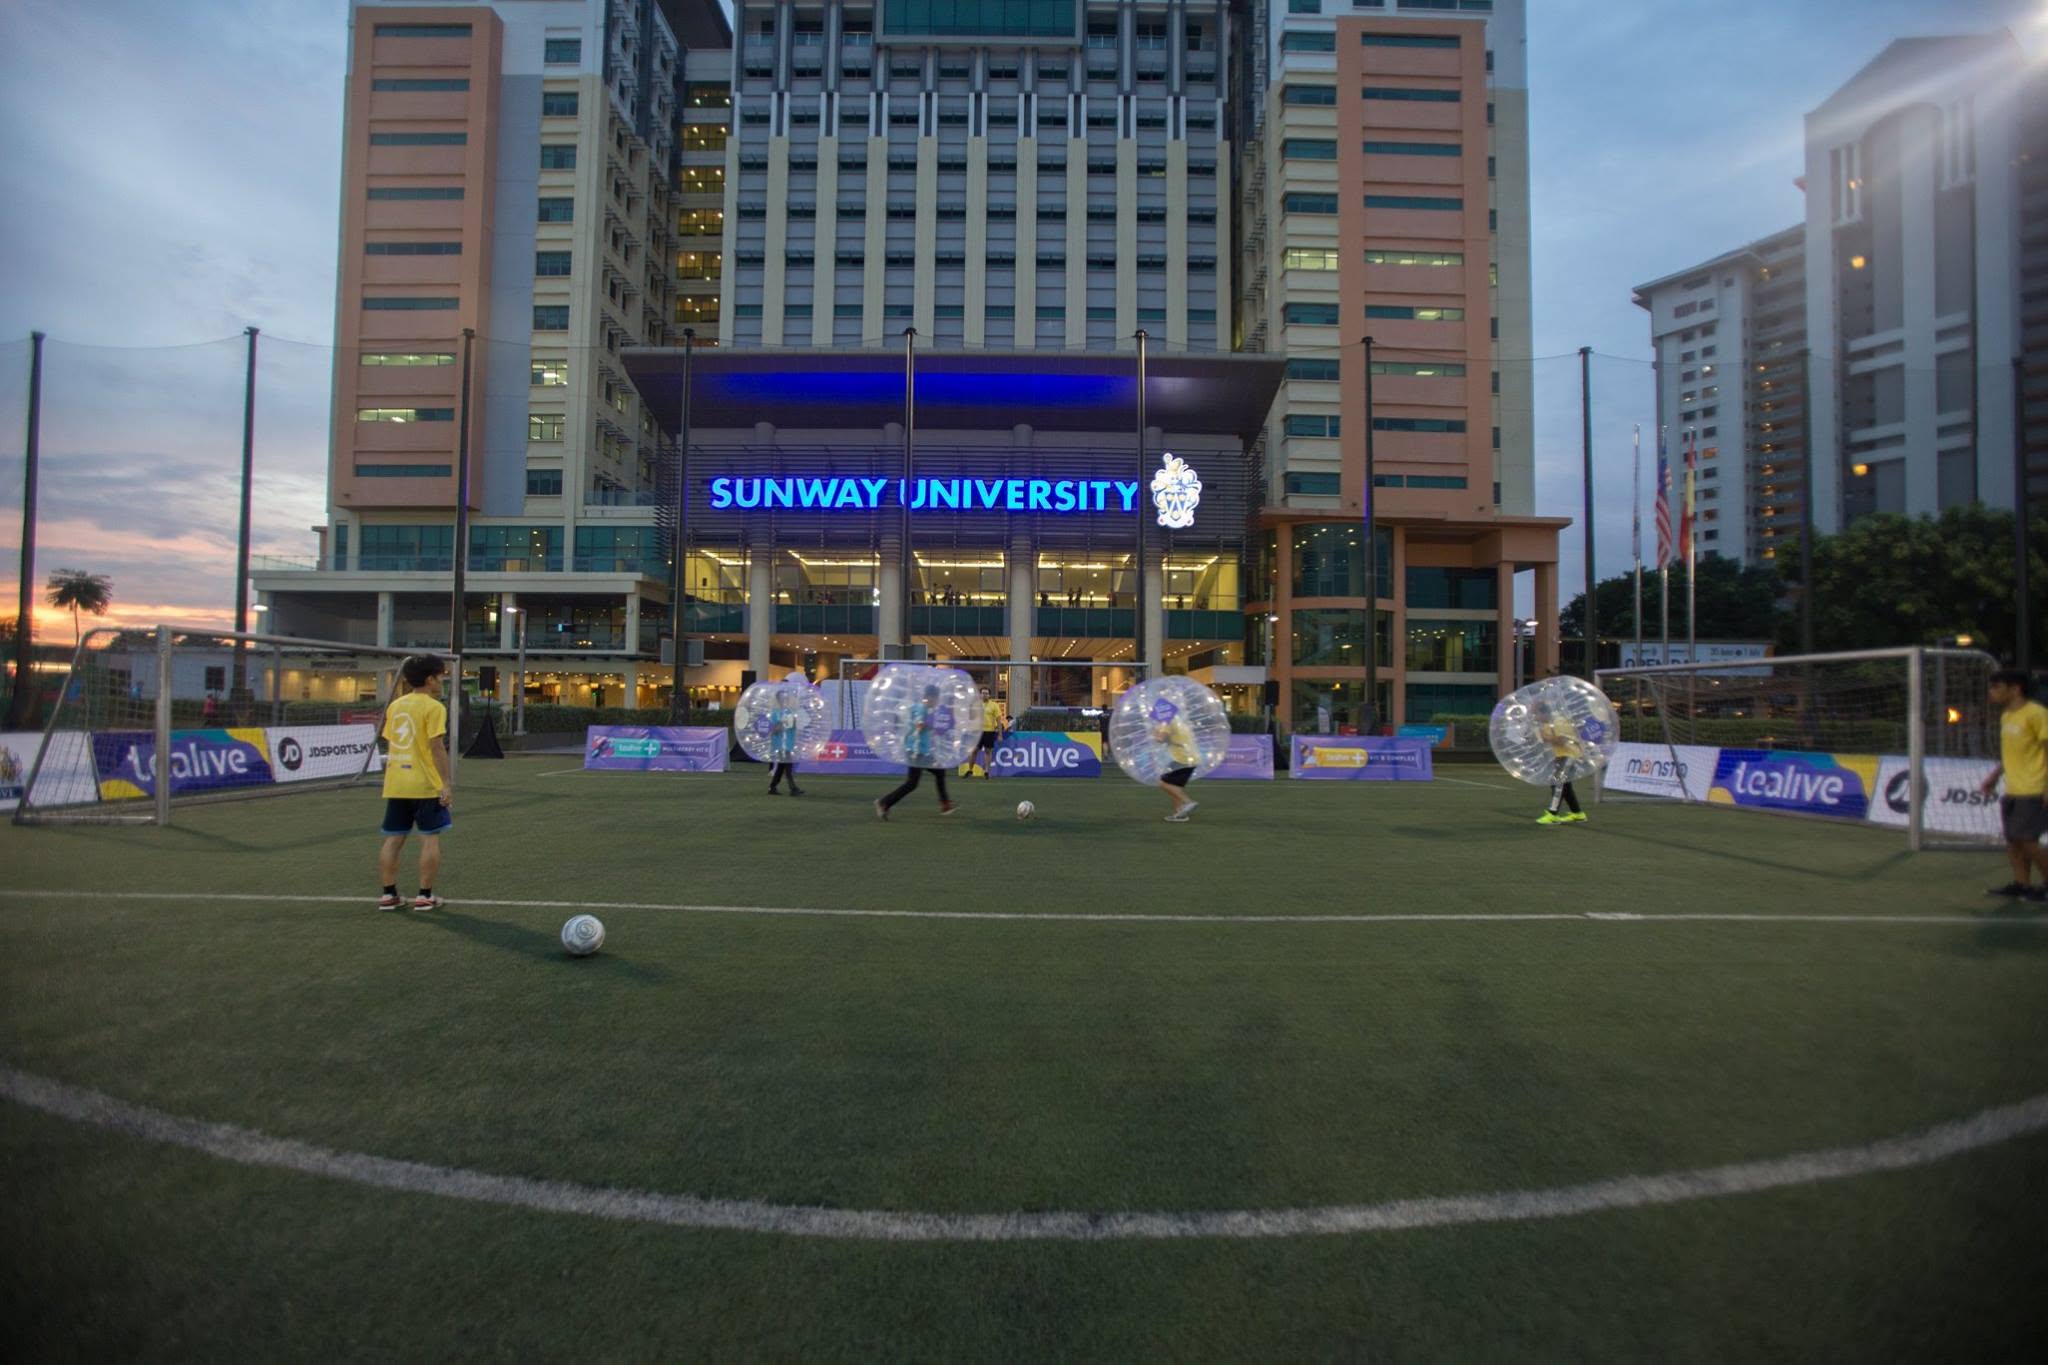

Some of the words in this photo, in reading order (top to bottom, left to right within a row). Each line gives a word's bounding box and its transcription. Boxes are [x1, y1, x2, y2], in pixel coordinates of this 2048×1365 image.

[711, 478, 888, 508] SUNWAY
[900, 479, 1139, 511] UNIVERSITY
[283, 744, 300, 762] JD
[990, 741, 1079, 768] ealive
[1735, 761, 1844, 805] tealive
